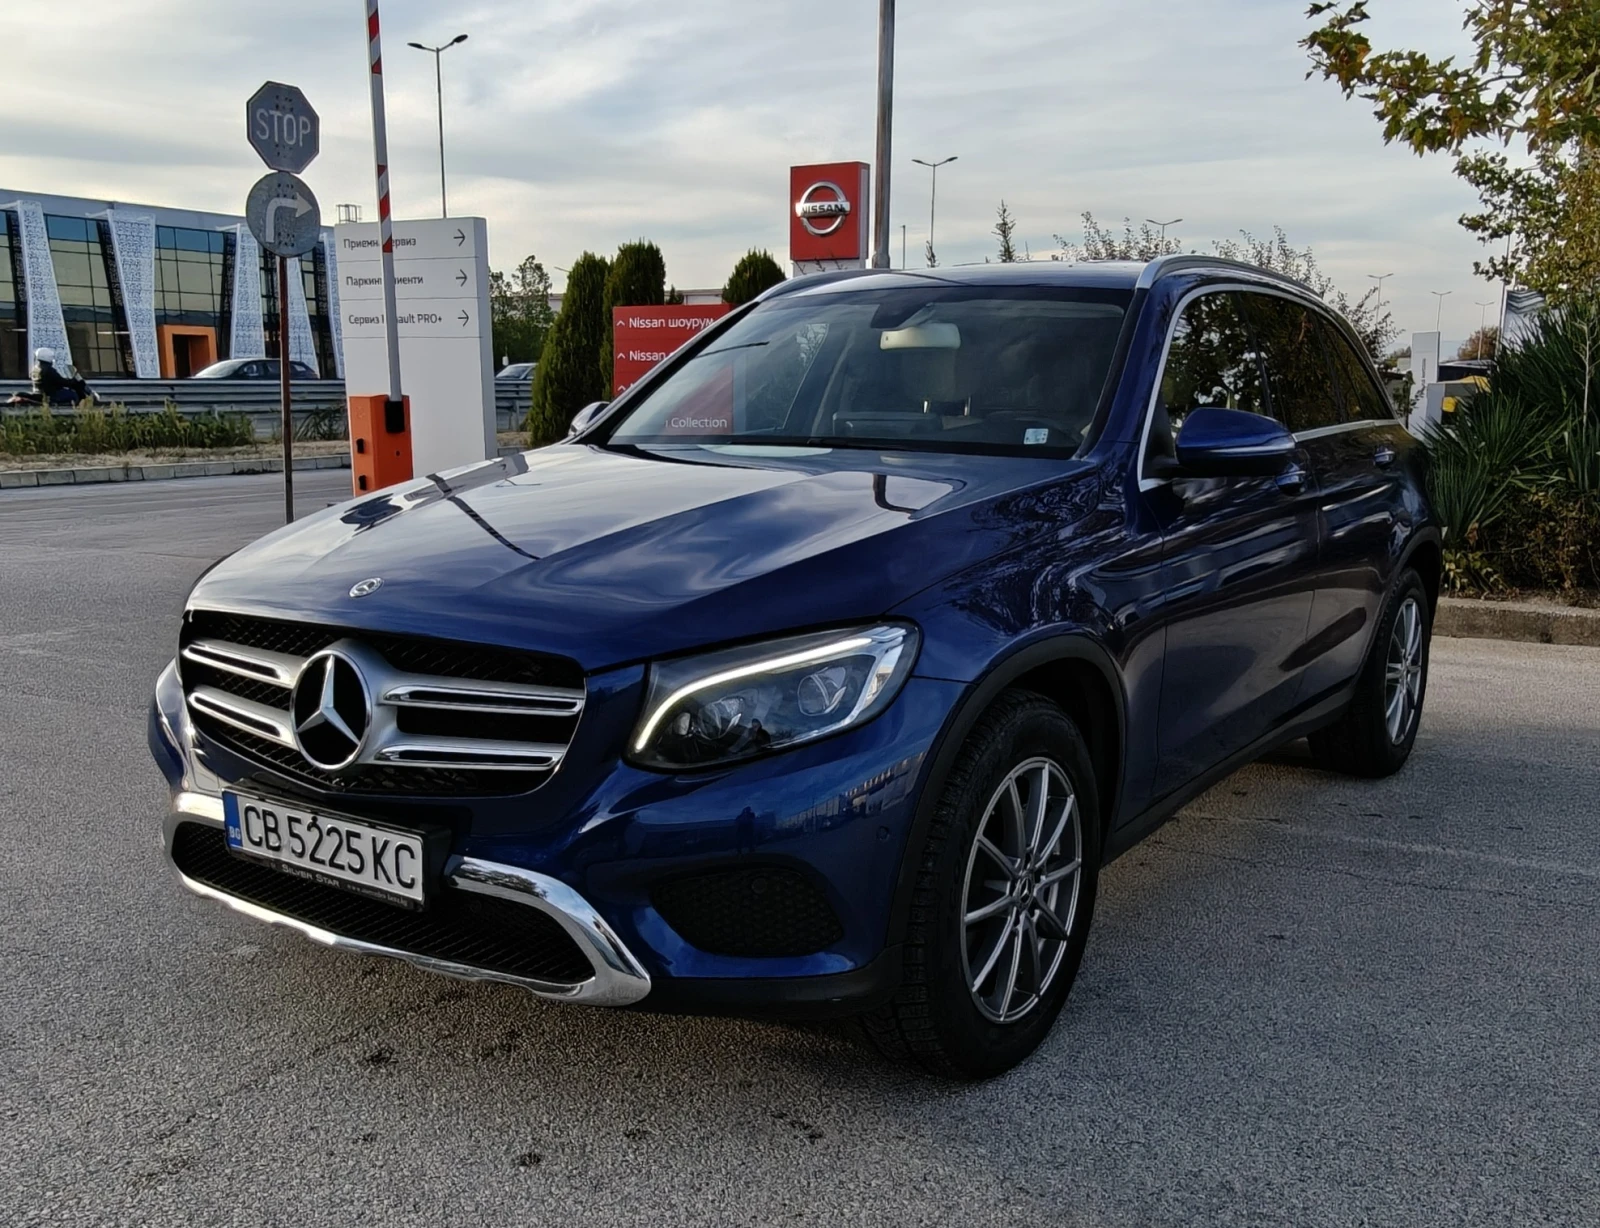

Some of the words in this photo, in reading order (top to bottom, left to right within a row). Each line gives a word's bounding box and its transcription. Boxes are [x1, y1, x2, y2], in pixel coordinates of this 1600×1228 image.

[256, 108, 311, 147] STOP
[802, 204, 846, 214] NISSAN
[343, 238, 381, 250] Приемн
[392, 238, 417, 249] ервиз
[394, 277, 424, 285] иенти
[348, 314, 380, 327] Сервиз
[417, 313, 442, 324] PRO+
[629, 317, 665, 328] Nissan
[629, 350, 666, 361] Nissan
[671, 417, 727, 428] Collection
[228, 825, 241, 841] BG
[315, 874, 340, 888] STAR
